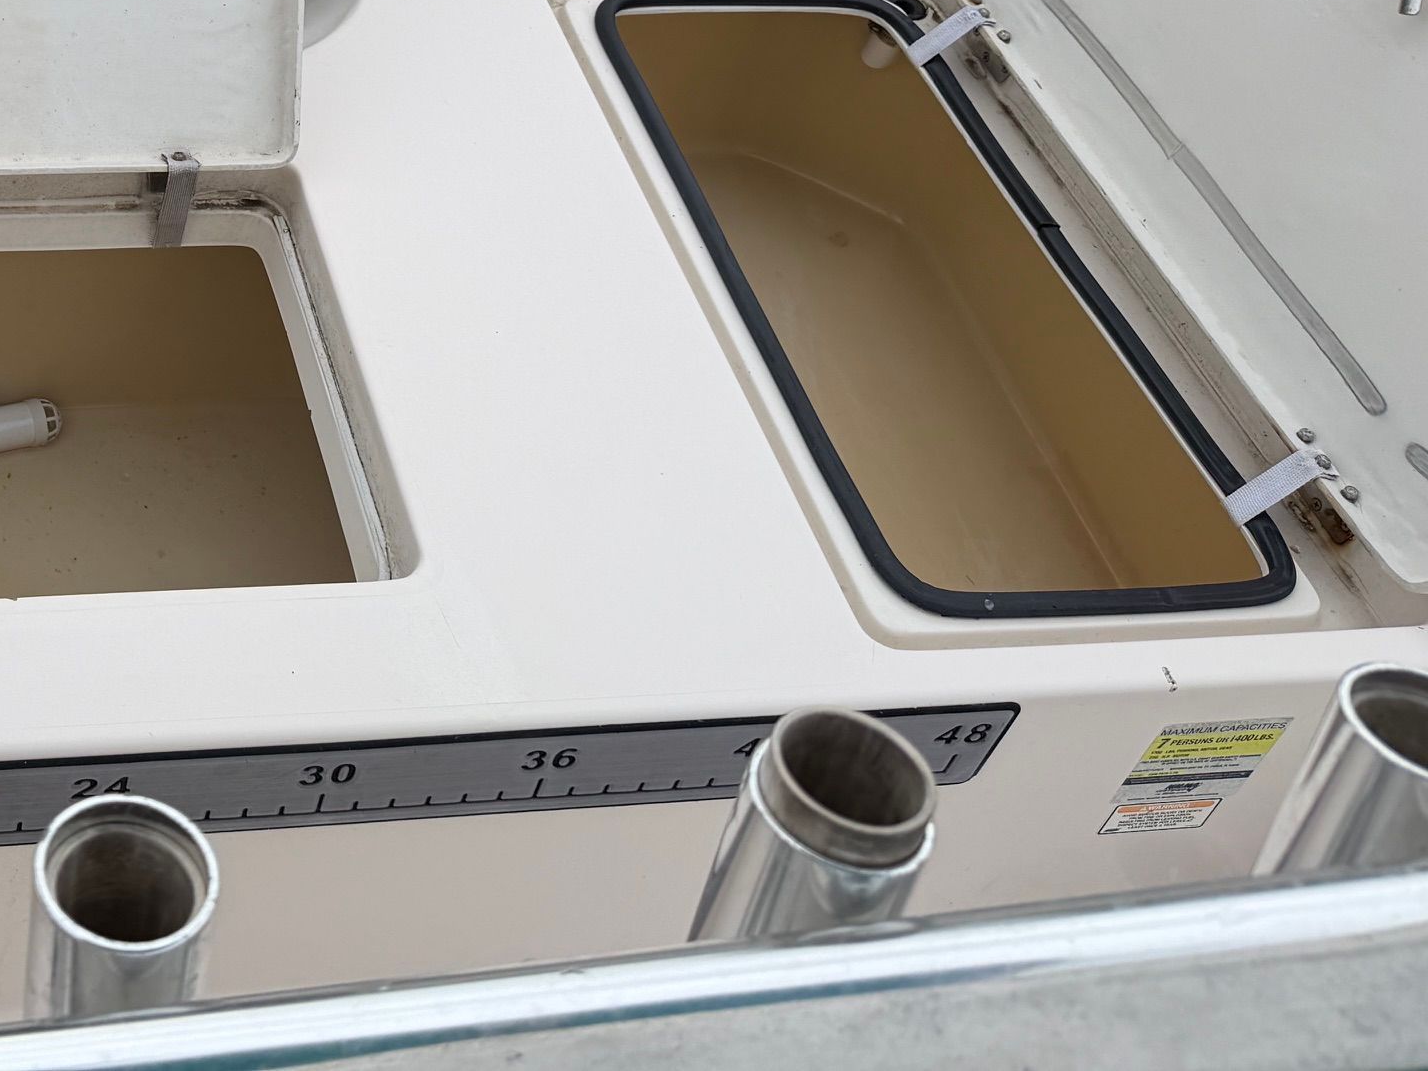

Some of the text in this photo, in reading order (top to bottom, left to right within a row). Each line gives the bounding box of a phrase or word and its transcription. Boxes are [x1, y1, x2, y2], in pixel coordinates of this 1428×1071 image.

[1160, 722, 1288, 737] MAXIMUM CAPACITIES
[1156, 738, 1172, 749] 7
[71, 775, 132, 800] 24
[298, 763, 357, 787] 30
[521, 748, 578, 771] 36
[934, 723, 993, 746] 48
